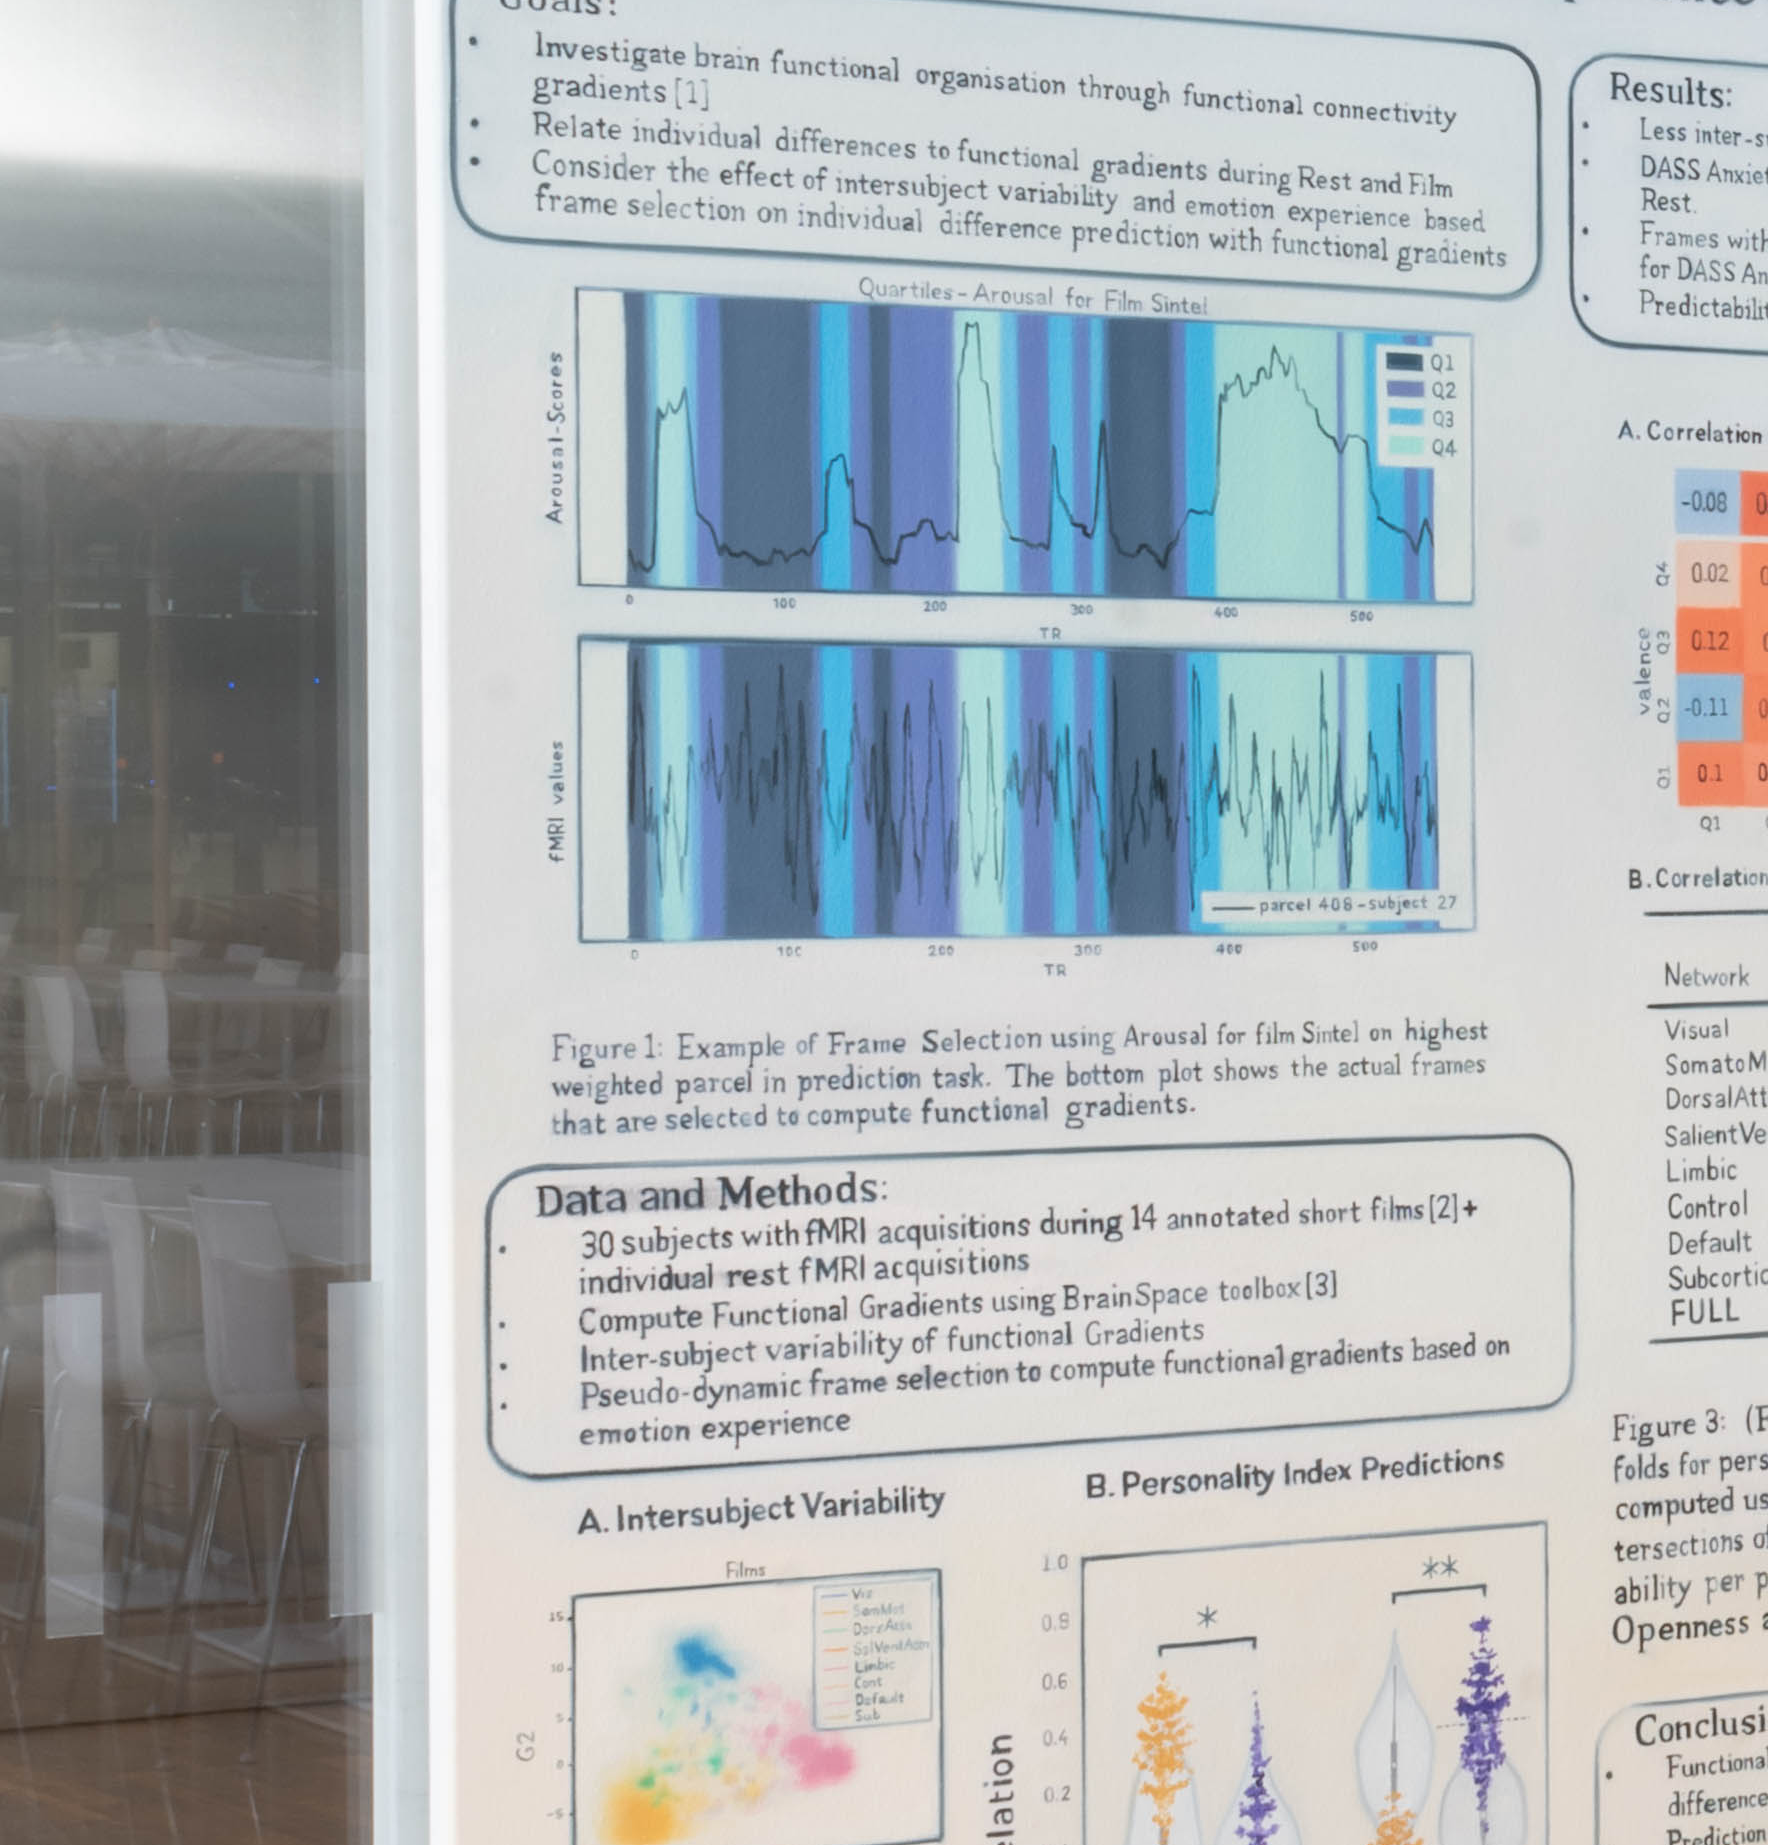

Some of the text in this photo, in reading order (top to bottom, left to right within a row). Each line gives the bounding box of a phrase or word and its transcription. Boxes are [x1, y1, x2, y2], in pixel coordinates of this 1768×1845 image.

[532, 73, 667, 106] gradients
[535, 30, 1457, 133] Investigate brain functional organisation through functional connectivity
[1610, 71, 1732, 109] Results:
[1639, 116, 1687, 142] Less
[1617, 419, 1641, 440] A.
[1646, 419, 1763, 445] Correlation
[1681, 489, 1728, 514] -0.08
[1664, 961, 1750, 988] Network
[1664, 1017, 1729, 1041] Visual
[1666, 1155, 1737, 1183] Limbic
[536, 1170, 887, 1217] Data and Methods:
[1667, 1188, 1748, 1220] Control
[1668, 1229, 1753, 1256] Default
[1671, 1297, 1740, 1327] FULL
[1086, 1448, 1504, 1499] B. Personality Index Predictions
[577, 1485, 946, 1535] A. Intersubject Variability
